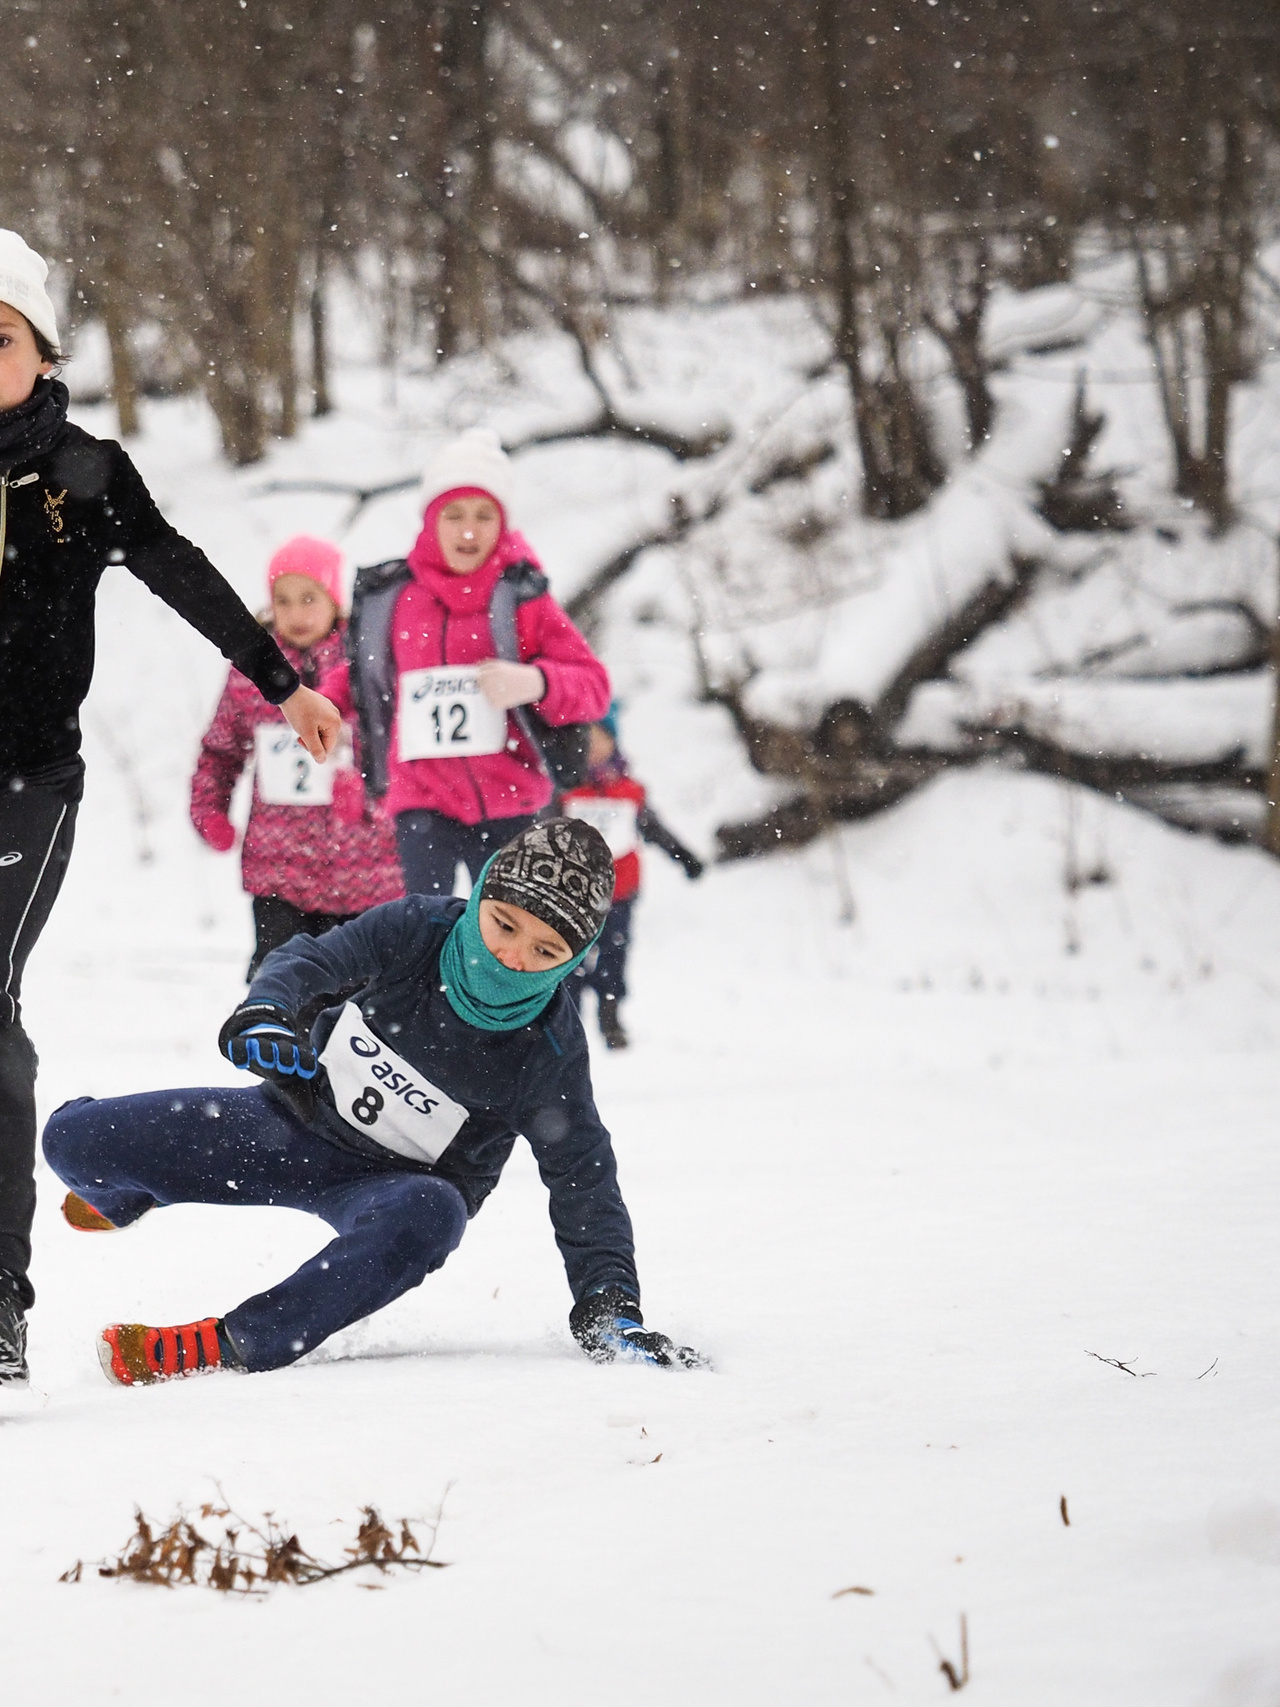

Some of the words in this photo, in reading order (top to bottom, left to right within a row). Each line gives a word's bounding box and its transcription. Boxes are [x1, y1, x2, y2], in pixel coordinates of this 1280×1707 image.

[431, 703, 469, 743] 12
[295, 758, 311, 794] 2
[351, 1086, 385, 1126] 8
[371, 1061, 440, 1115] asics
